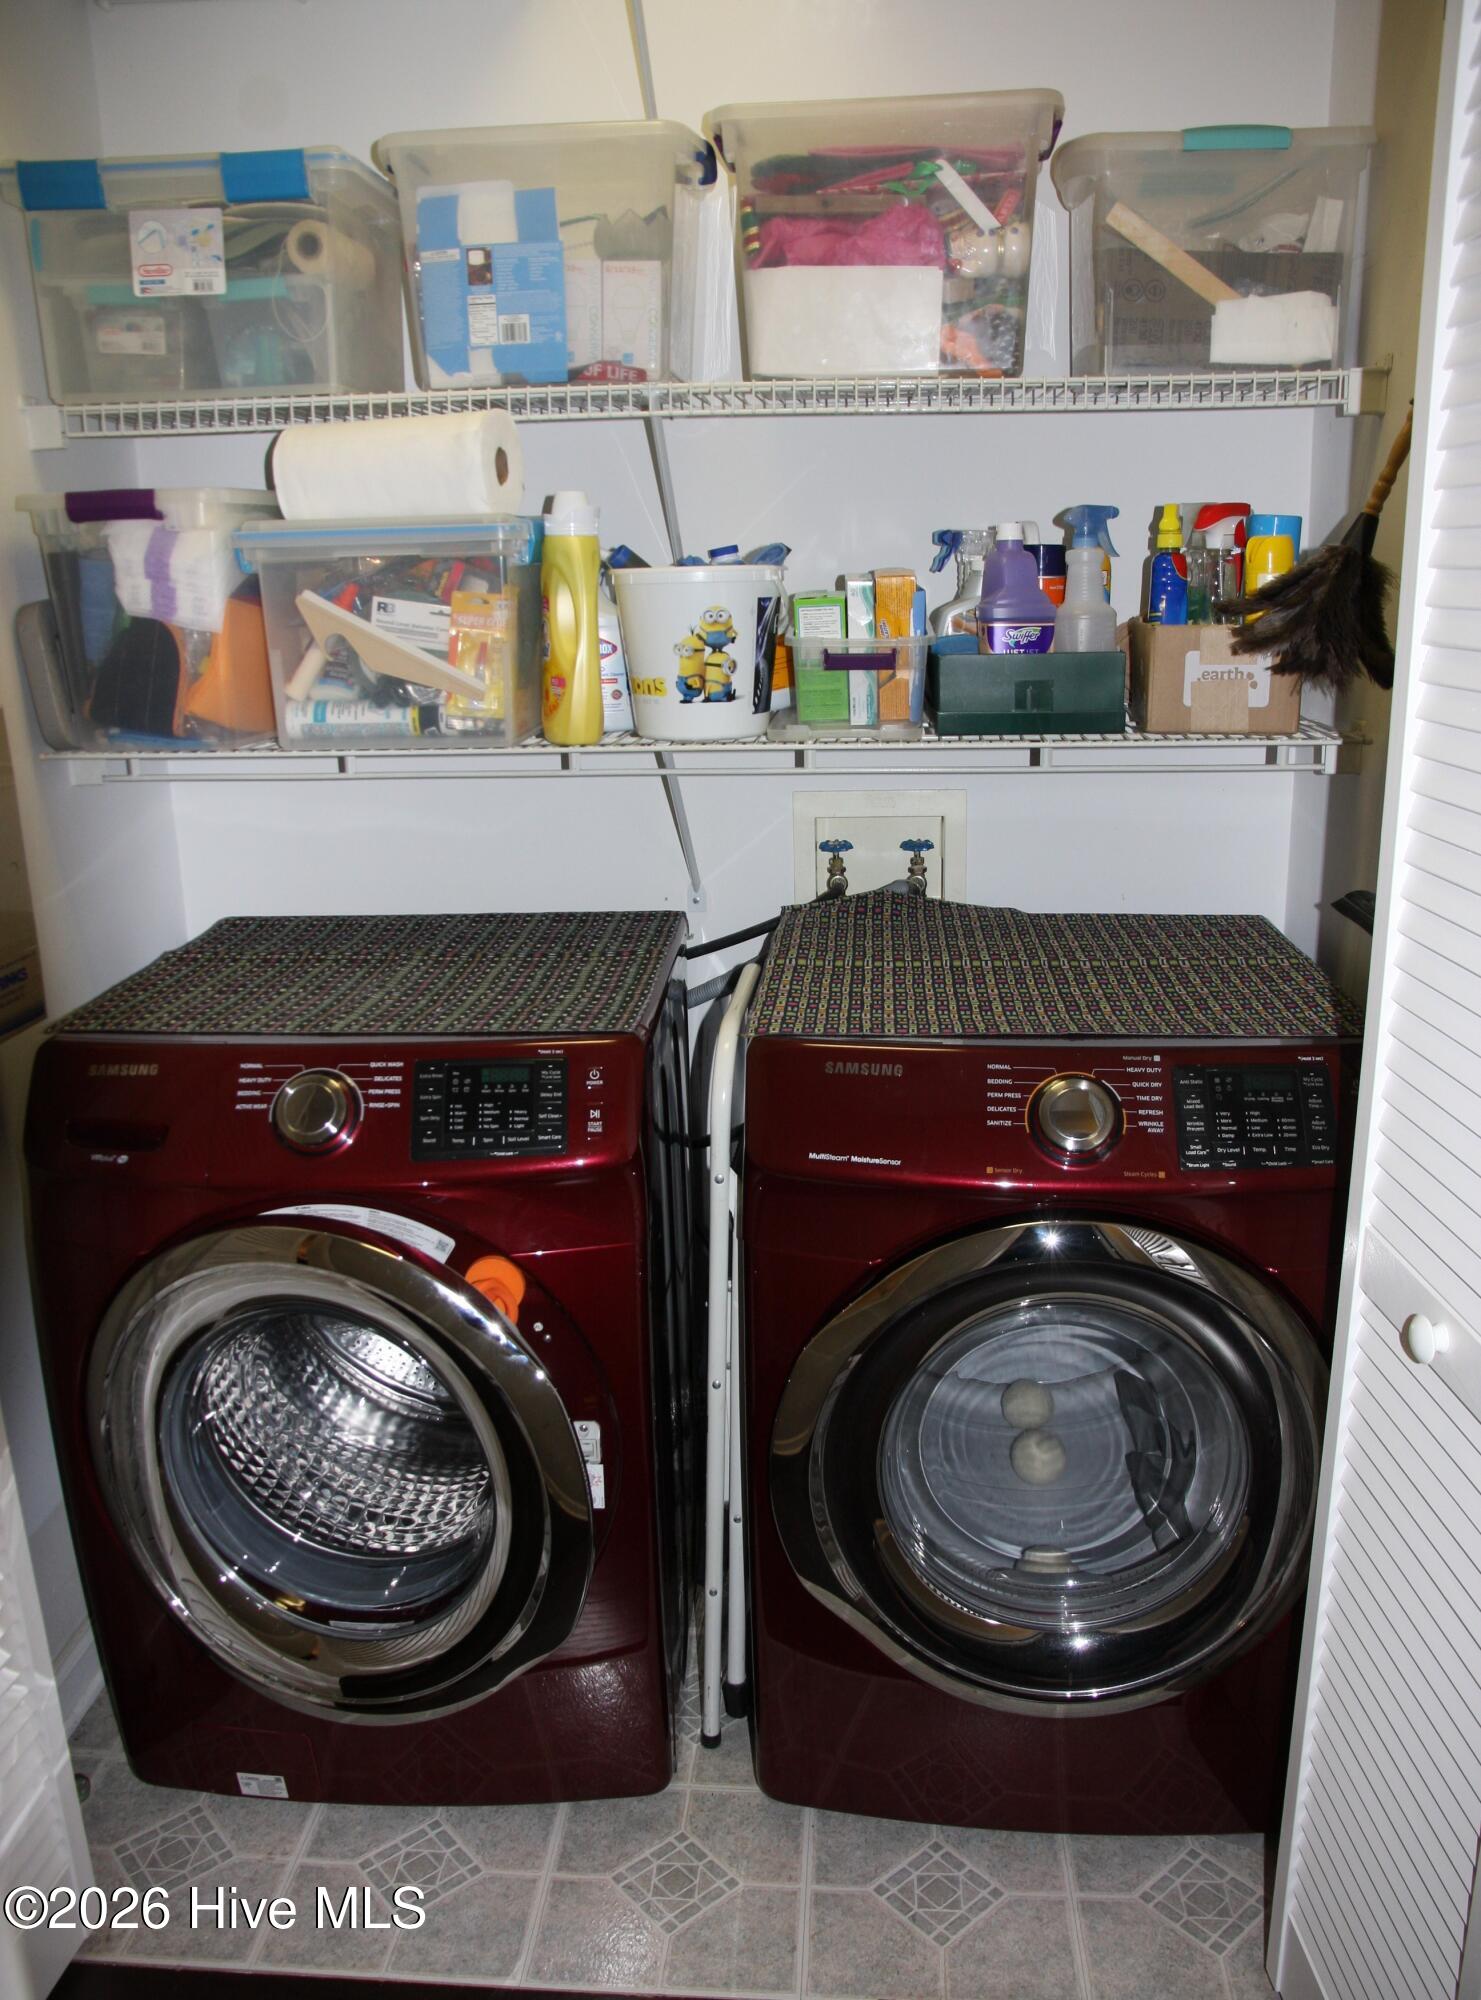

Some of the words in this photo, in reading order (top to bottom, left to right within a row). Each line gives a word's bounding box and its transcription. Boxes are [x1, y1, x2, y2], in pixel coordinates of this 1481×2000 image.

[606, 364, 641, 381] LIFE
[1002, 627, 1042, 645] Swiffer
[1201, 666, 1245, 681] earth
[88, 1063, 160, 1077] SAMSUNG
[824, 1061, 904, 1077] SAMSUNG
[986, 1119, 1012, 1127] SANITIZE
[850, 1155, 902, 1166] MoistureSensor
